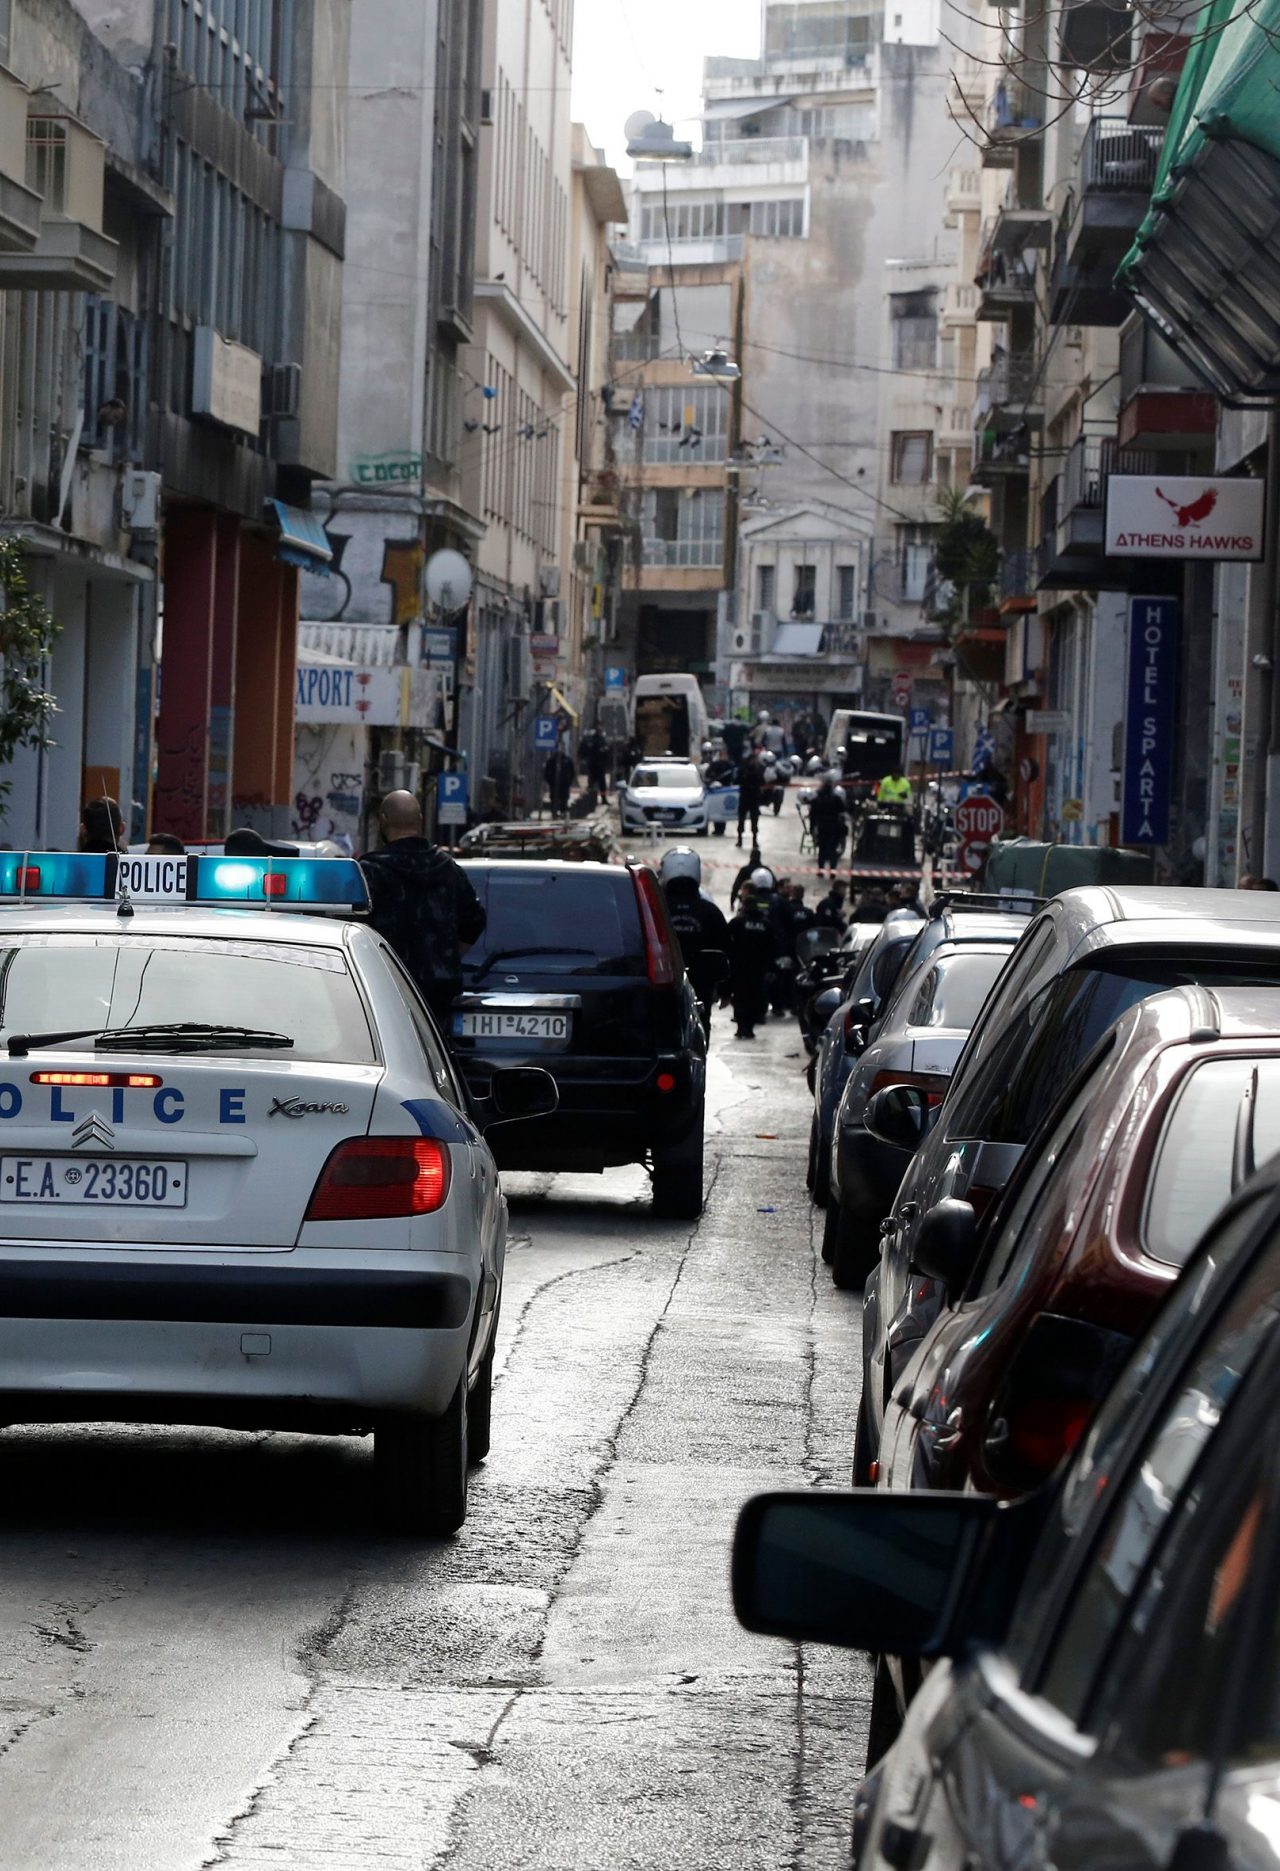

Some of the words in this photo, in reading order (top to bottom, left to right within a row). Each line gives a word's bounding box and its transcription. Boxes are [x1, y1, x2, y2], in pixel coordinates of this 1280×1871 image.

[1189, 535, 1254, 551] HAWKS
[1143, 605, 1162, 704] HOTEL
[539, 720, 553, 738] P
[935, 732, 948, 748] P
[444, 775, 461, 797] P
[1137, 716, 1157, 838] SPARTA
[957, 807, 999, 833] STOP
[118, 861, 187, 893] POLICE
[83, 1162, 169, 1202] 23360
